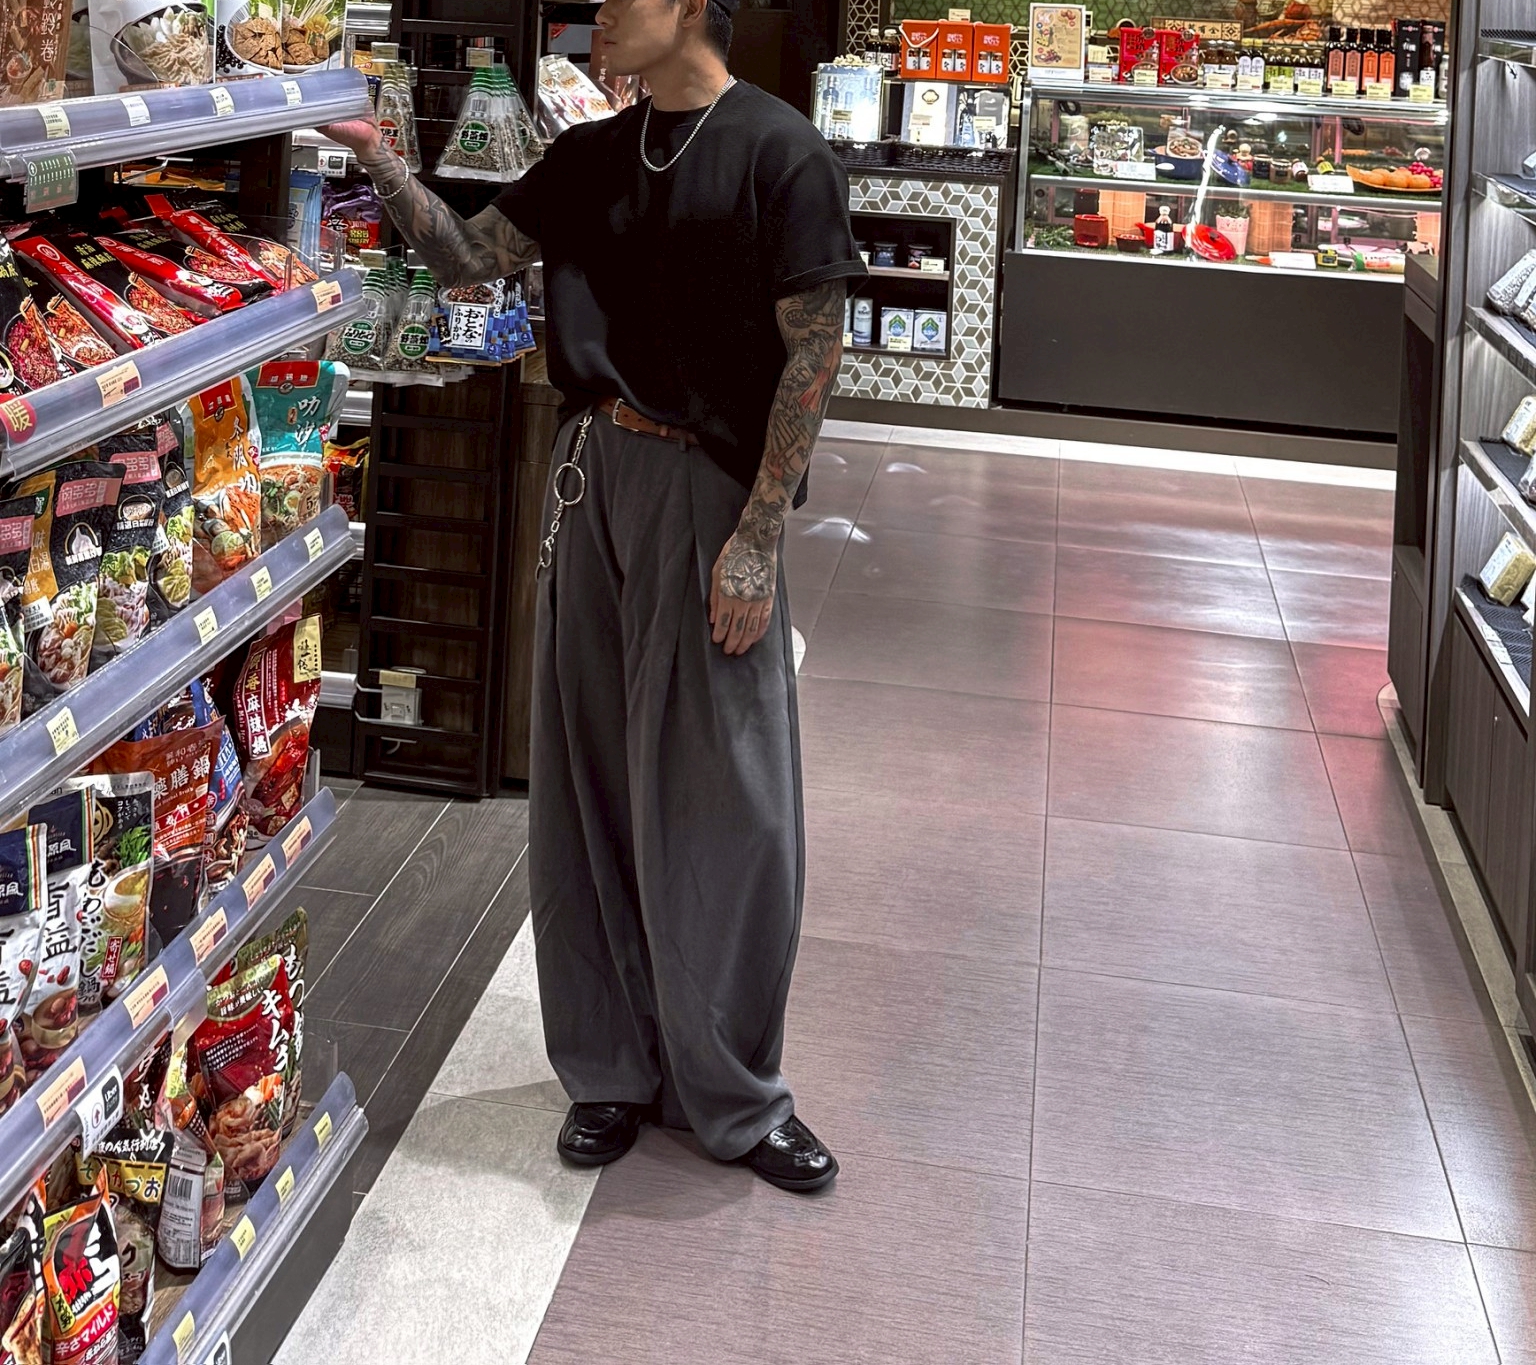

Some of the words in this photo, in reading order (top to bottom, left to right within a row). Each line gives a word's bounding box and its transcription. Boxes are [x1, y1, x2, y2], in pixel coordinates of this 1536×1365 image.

[452, 308, 464, 341] ふりかけ
[55, 1303, 116, 1355] 辛さマイルド
